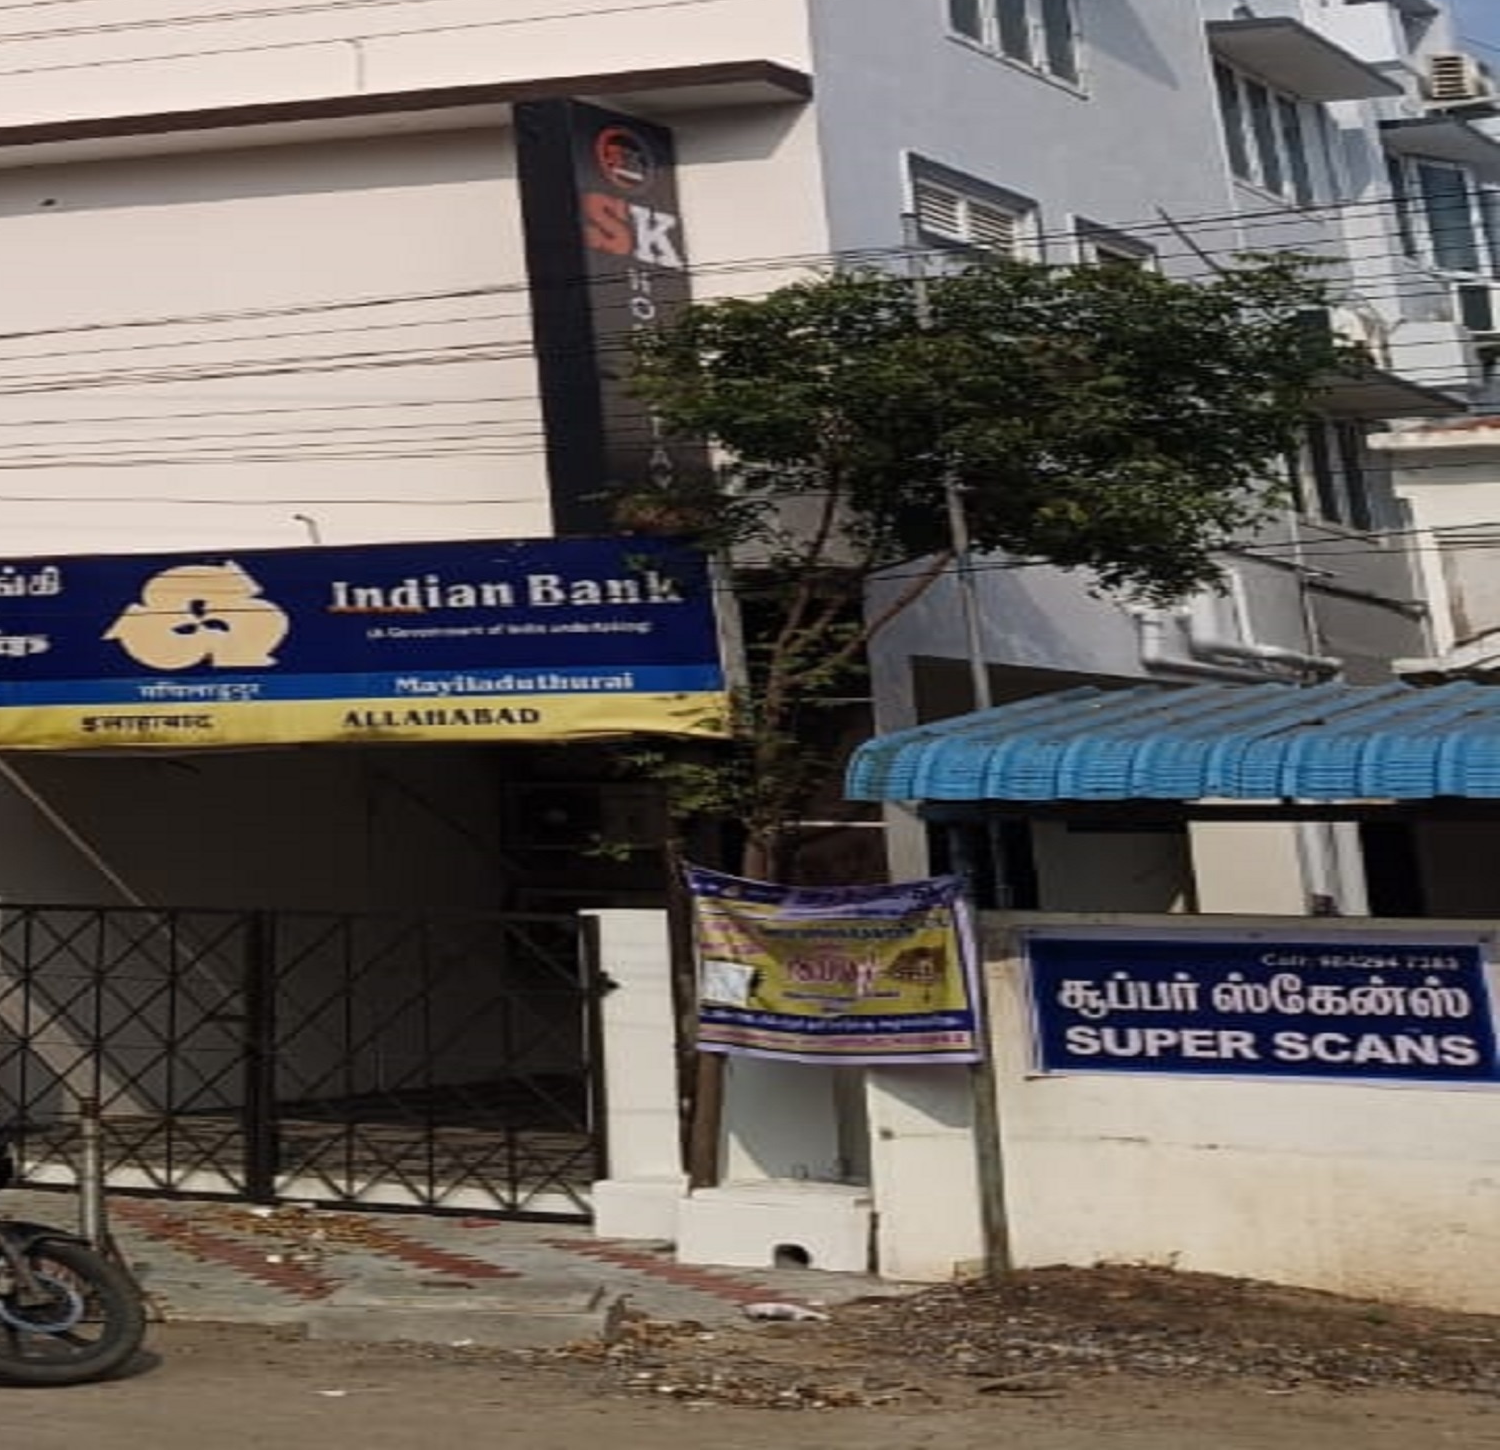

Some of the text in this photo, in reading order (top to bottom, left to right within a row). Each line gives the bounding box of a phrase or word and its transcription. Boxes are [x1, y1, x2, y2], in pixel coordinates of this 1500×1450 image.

[580, 193, 685, 269] SK
[330, 569, 684, 611] Indian Bank
[394, 672, 633, 698] Mayiladuthurai
[342, 707, 541, 729] ALLAHABAD
[1058, 970, 1472, 1019] சூப்பர் ஸ்கேன்ஸ்
[1065, 1025, 1481, 1067] SUPER SCANS
